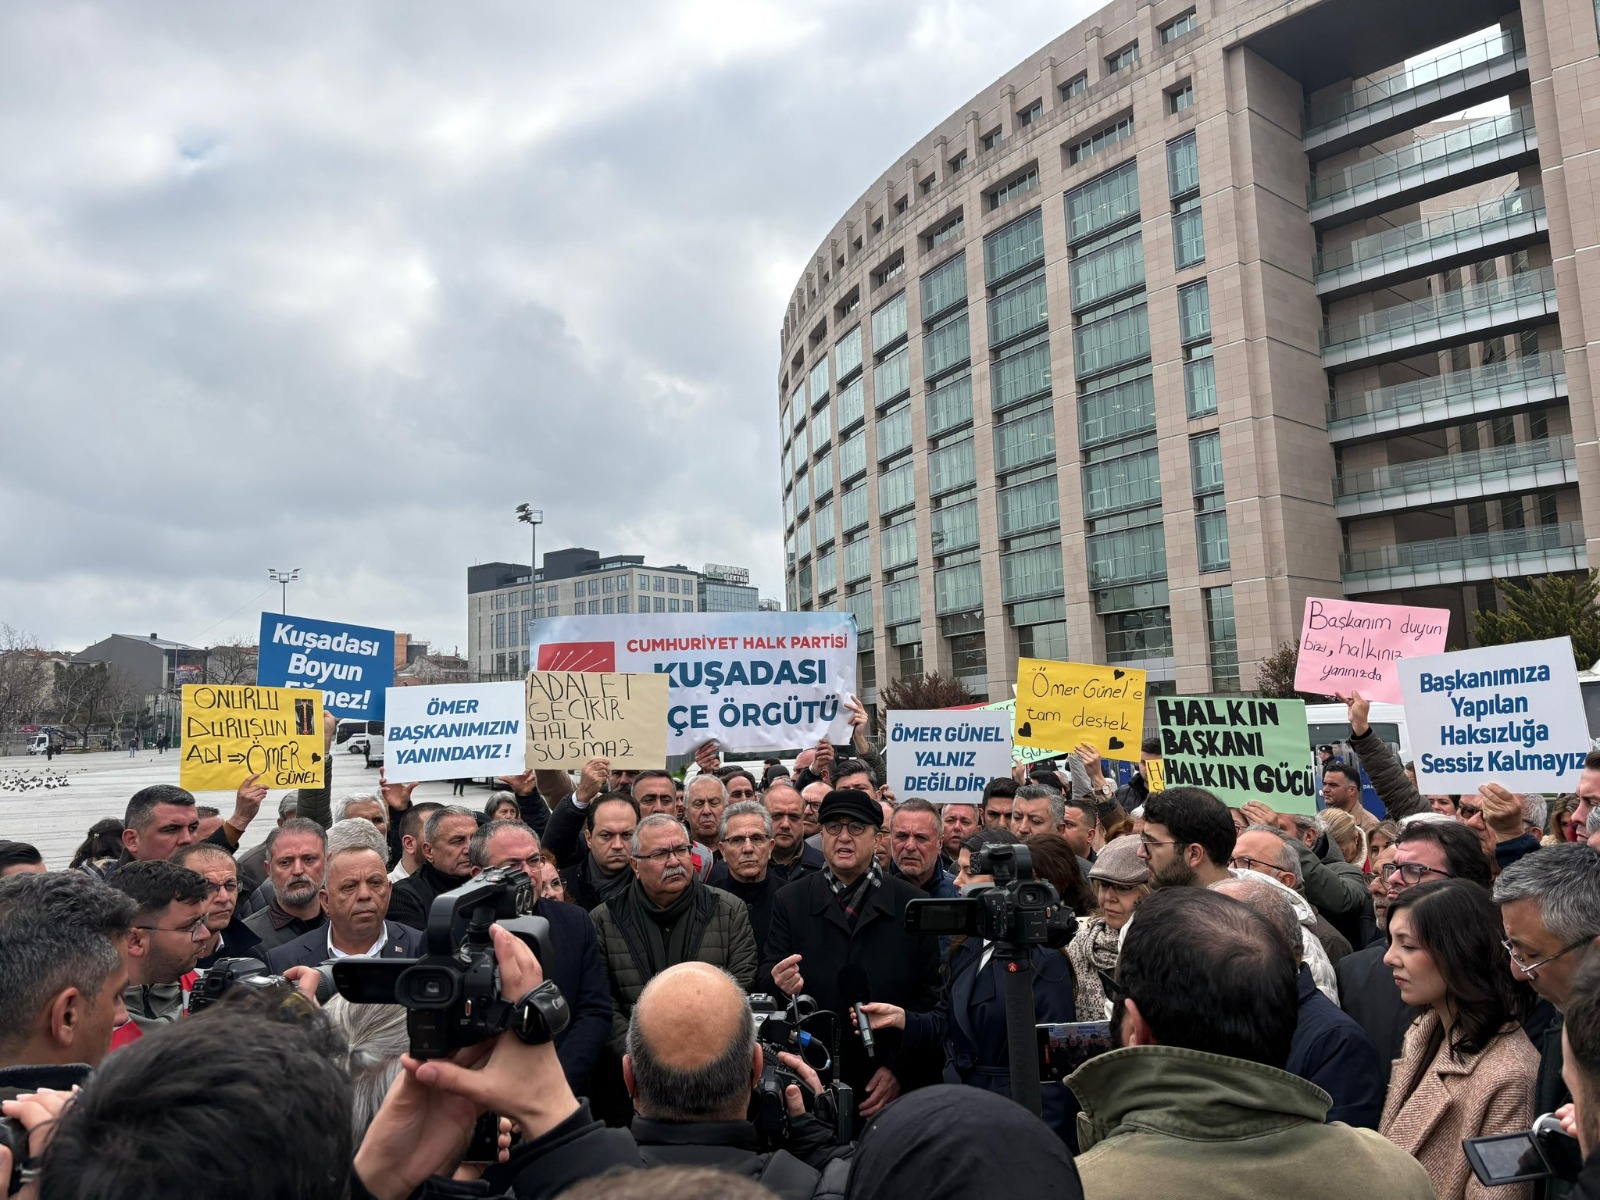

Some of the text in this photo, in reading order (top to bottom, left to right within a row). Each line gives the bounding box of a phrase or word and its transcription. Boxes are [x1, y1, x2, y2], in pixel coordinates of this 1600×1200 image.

[1308, 600, 1442, 641] Başkanım duyun
[272, 622, 380, 656] Kuşadası
[626, 633, 848, 653] CUMHURİYET HALK PARTİSİ
[1303, 633, 1403, 661] bizi, halkınız
[287, 652, 363, 684] Boyun
[654, 659, 827, 695] KUŞADASI
[1319, 664, 1382, 681] yanınızda
[1420, 664, 1551, 698] Başkanımıza
[193, 687, 279, 711] ONURLU
[529, 673, 637, 701] ADALET
[426, 697, 479, 716] ÖMER
[718, 694, 839, 728] ÖRGÜTÜ
[1025, 705, 1132, 732] tam destek
[1157, 699, 1280, 727] HALKIN
[1450, 693, 1529, 722] Yapılan
[187, 716, 287, 740] DURUŞUN
[387, 719, 519, 745] BAŞKANIMIZIN
[529, 721, 595, 741] HALK
[891, 723, 1004, 742] ÖMER GÜNEL
[1440, 718, 1549, 749] Haksızlığa
[1161, 728, 1264, 758] BAŞKANI
[186, 740, 305, 775] ADI ÖMER
[914, 751, 977, 767] YALNIZ
[1421, 750, 1588, 777] Sessiz Kalmayız
[275, 770, 321, 786] GÜNEL
[903, 772, 986, 792] DEĞİLDİR
[1163, 757, 1251, 791] HALKIN
[1253, 761, 1315, 797] GÜCÜ
